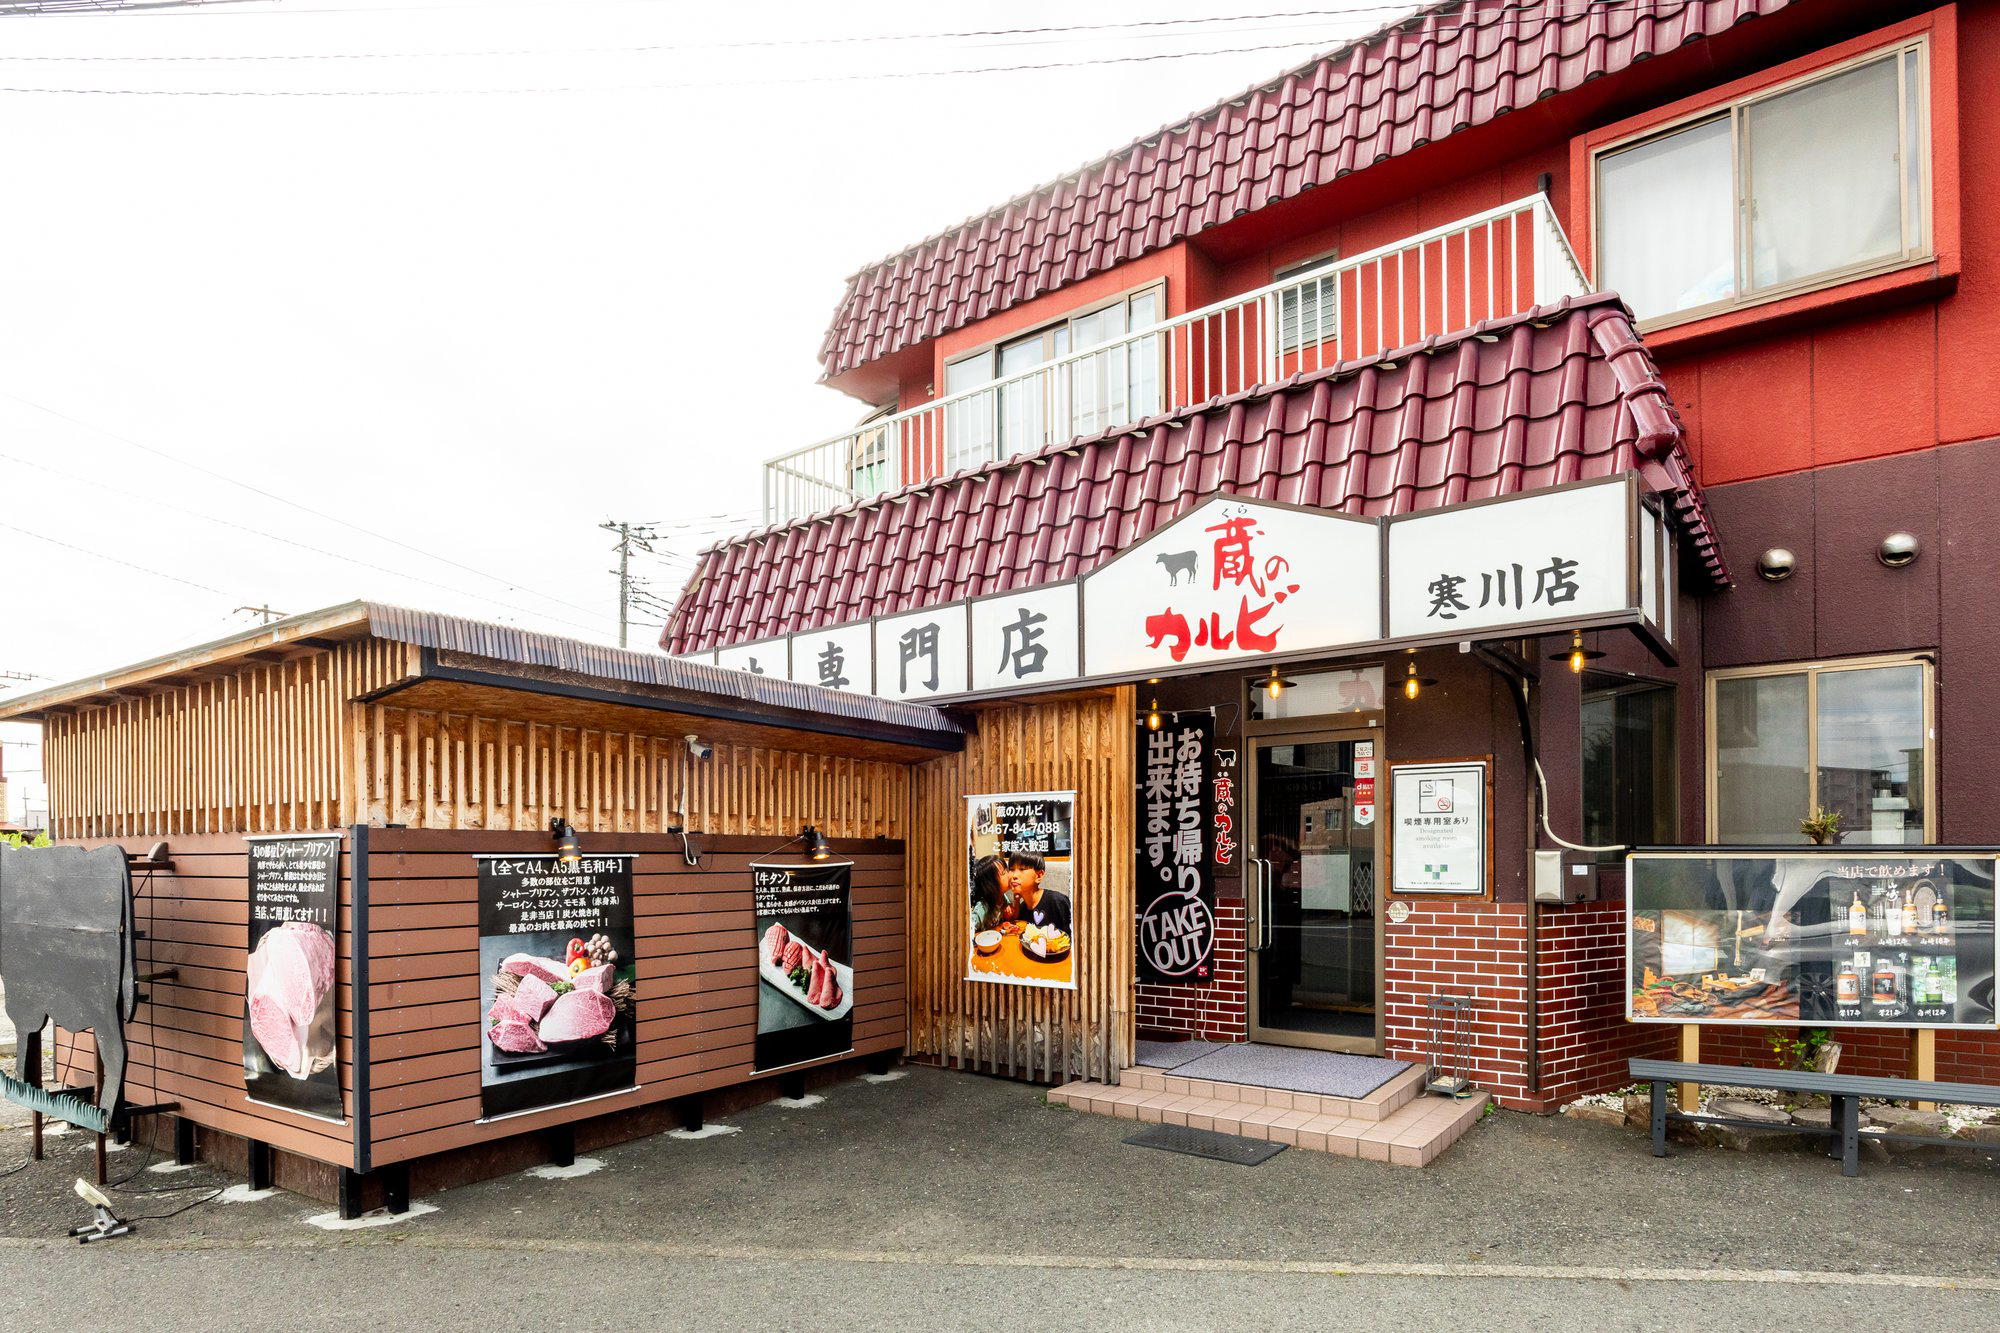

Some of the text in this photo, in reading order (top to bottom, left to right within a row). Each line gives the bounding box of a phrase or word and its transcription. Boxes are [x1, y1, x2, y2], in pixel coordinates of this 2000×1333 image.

[1221, 504, 1248, 518] くら
[1205, 517, 1289, 598] 蔵の
[1426, 556, 1580, 620] 寒川店
[1145, 584, 1301, 663] カルビ
[996, 803, 1044, 818] 蔵のカルビ
[1145, 730, 1175, 882] 出来ます。
[1172, 727, 1204, 900] お持ち帰り
[981, 822, 1060, 836] 0467-84-7088
[1212, 777, 1237, 866] 蔵のカルビ
[1404, 816, 1469, 826] 喫煙専用室あり
[1419, 827, 1453, 835] Designated
[991, 840, 1049, 853] ご家族大歓迎
[490, 859, 623, 876] 【全てA4、A5黒毛和牛】
[1838, 864, 1945, 878] 当店で飲めます！
[521, 876, 597, 888] 多数の部位をご用意！
[520, 908, 600, 922] 是非当店！炭火焼き肉
[1143, 901, 1207, 943] TAKE
[1153, 930, 1204, 971] OUT
